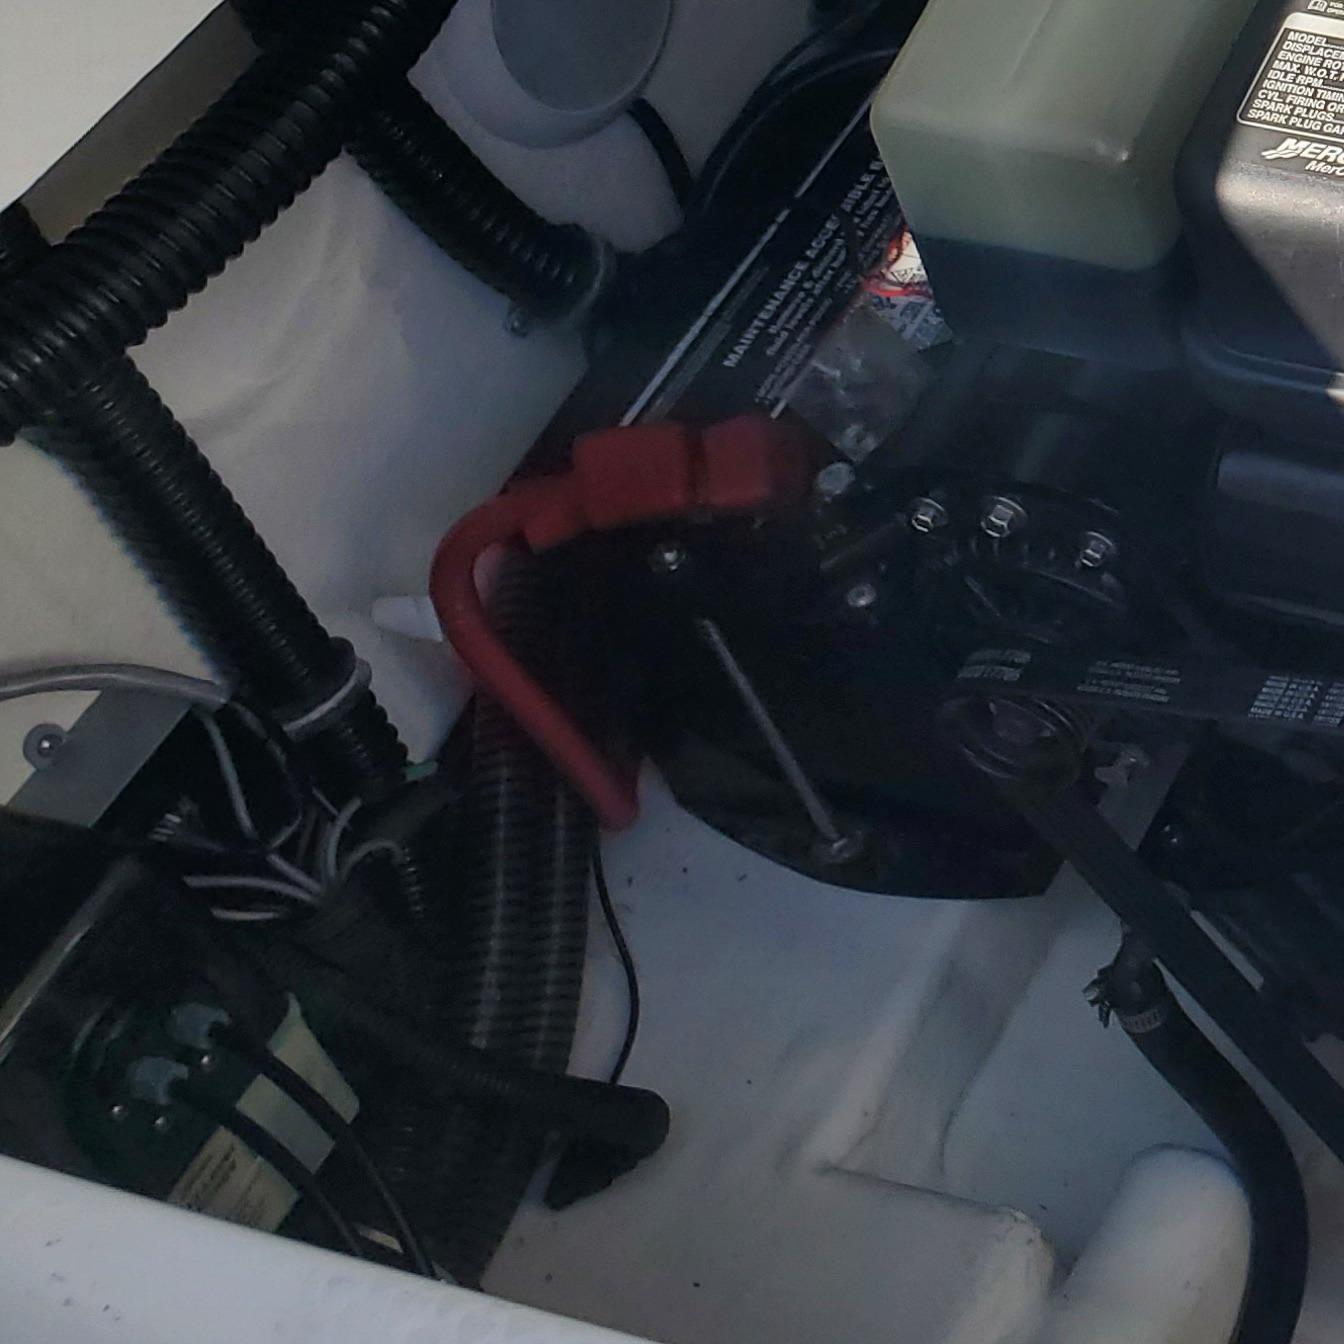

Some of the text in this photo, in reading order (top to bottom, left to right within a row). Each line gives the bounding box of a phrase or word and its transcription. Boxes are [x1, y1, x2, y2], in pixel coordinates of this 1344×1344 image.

[1278, 50, 1322, 67] ENGINE
[1267, 69, 1294, 82] IDLE
[1272, 60, 1301, 74] MAX.
[1304, 66, 1338, 81] W.O.T.
[1262, 79, 1315, 96] IGNITION
[1252, 99, 1293, 115] SPARK
[1257, 89, 1283, 101] CYL.
[1286, 95, 1326, 110] FIRING
[1247, 108, 1290, 125] SPARK
[1289, 116, 1322, 130] PLUG
[723, 260, 809, 368] MAINTENANCE
